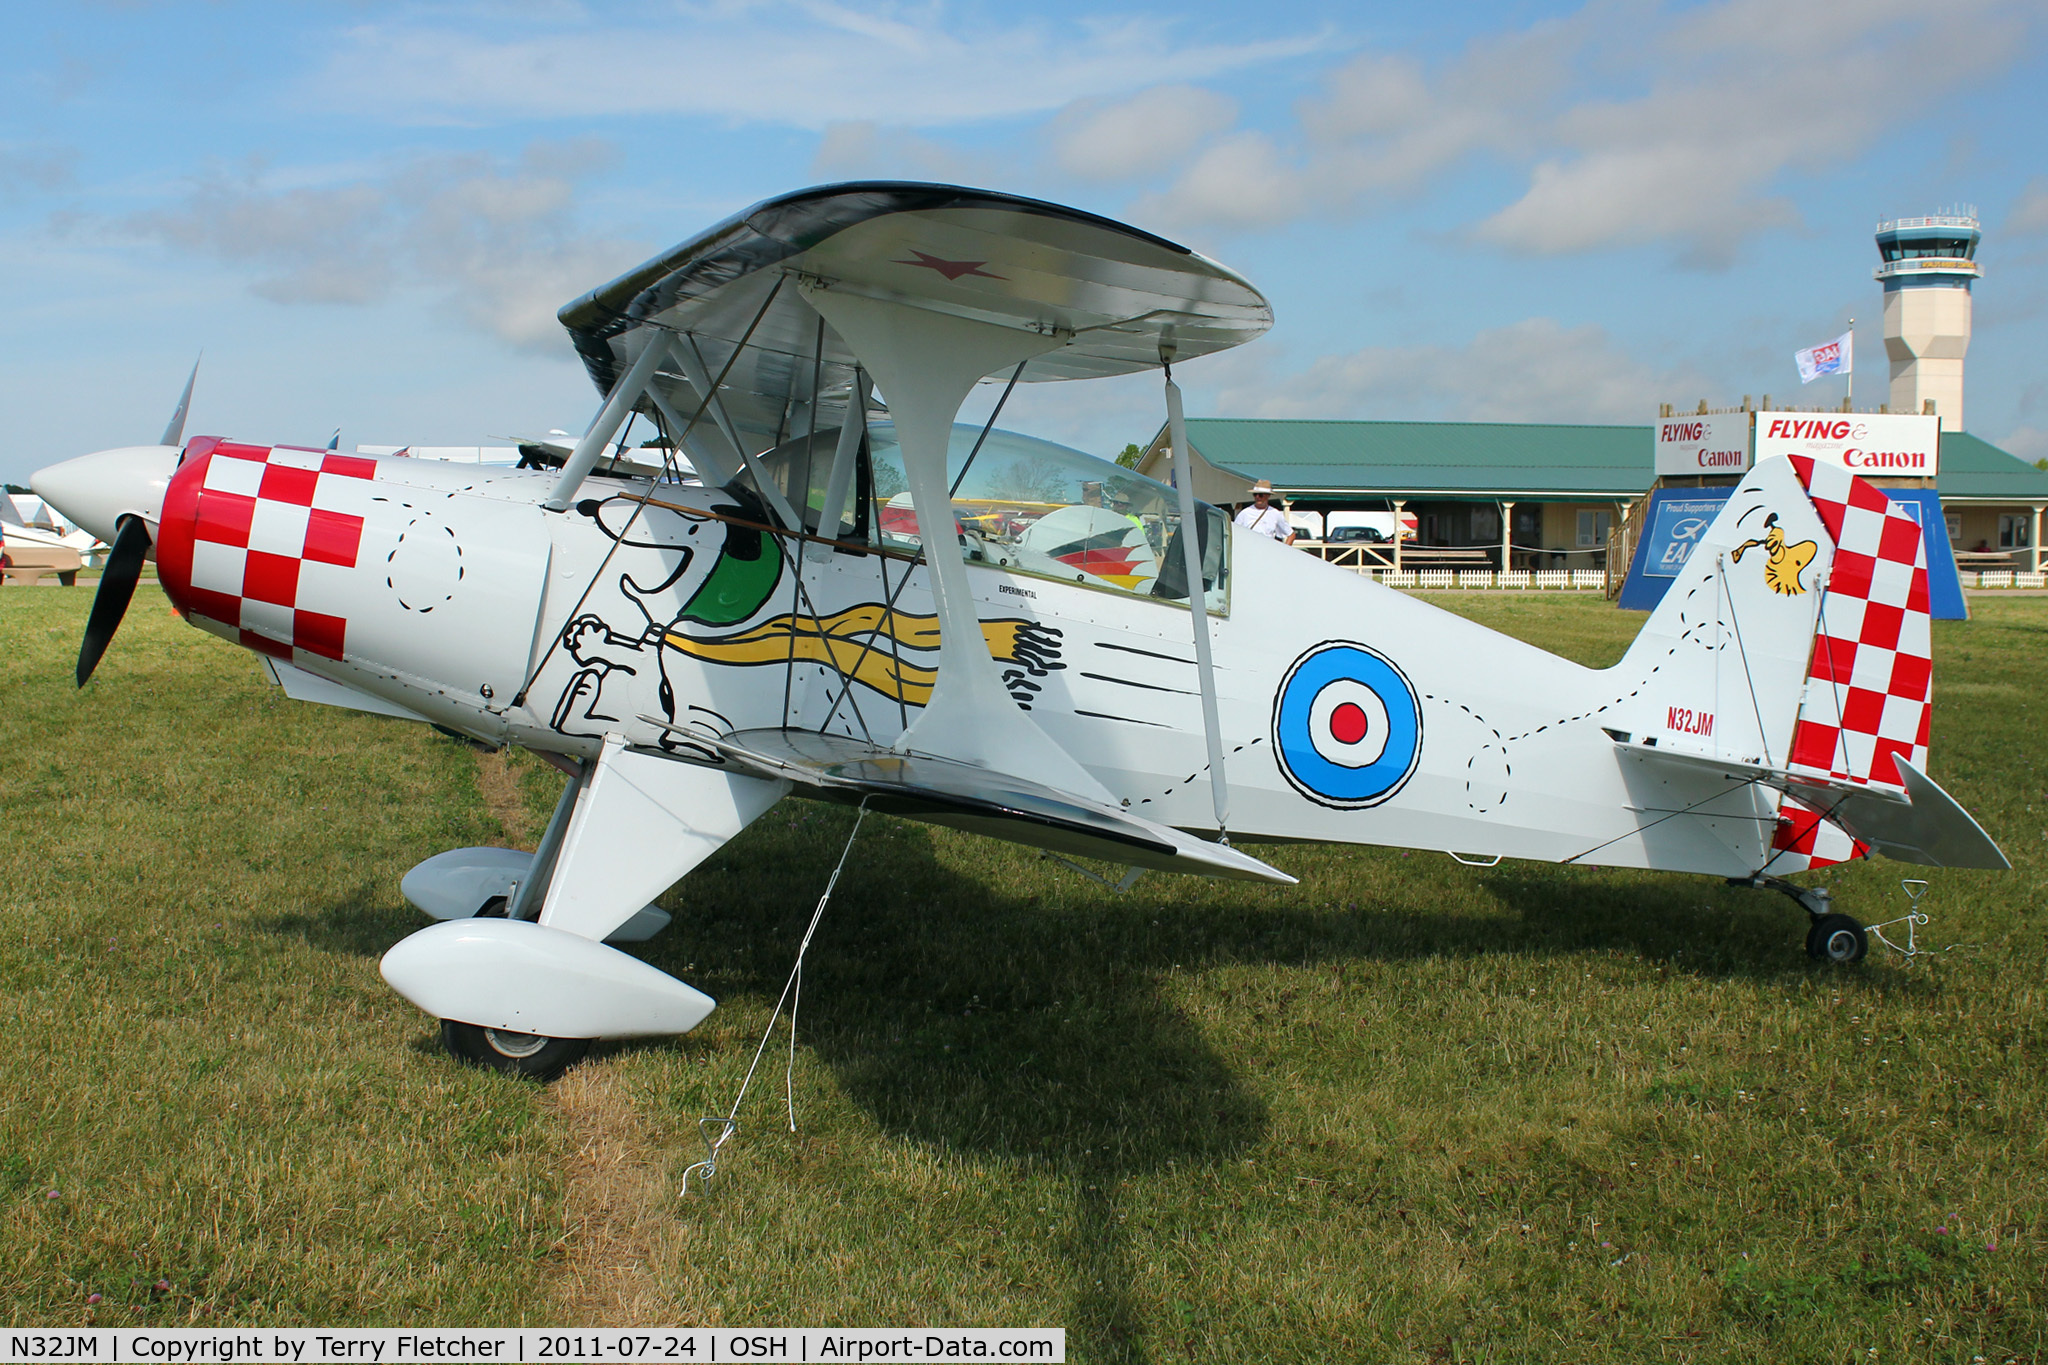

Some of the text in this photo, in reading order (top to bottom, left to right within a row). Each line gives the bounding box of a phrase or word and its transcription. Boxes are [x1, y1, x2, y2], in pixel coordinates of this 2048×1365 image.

[1661, 422, 1702, 442] FLYING
[1768, 420, 1850, 439] FLYING
[1698, 448, 1742, 467] Canon
[1843, 448, 1925, 468] Canon
[1666, 503, 1684, 512] Proud
[1684, 503, 1716, 514] Supporters
[999, 585, 1037, 599] EXPERIMENTAL
[1667, 706, 1714, 737] N32JM
